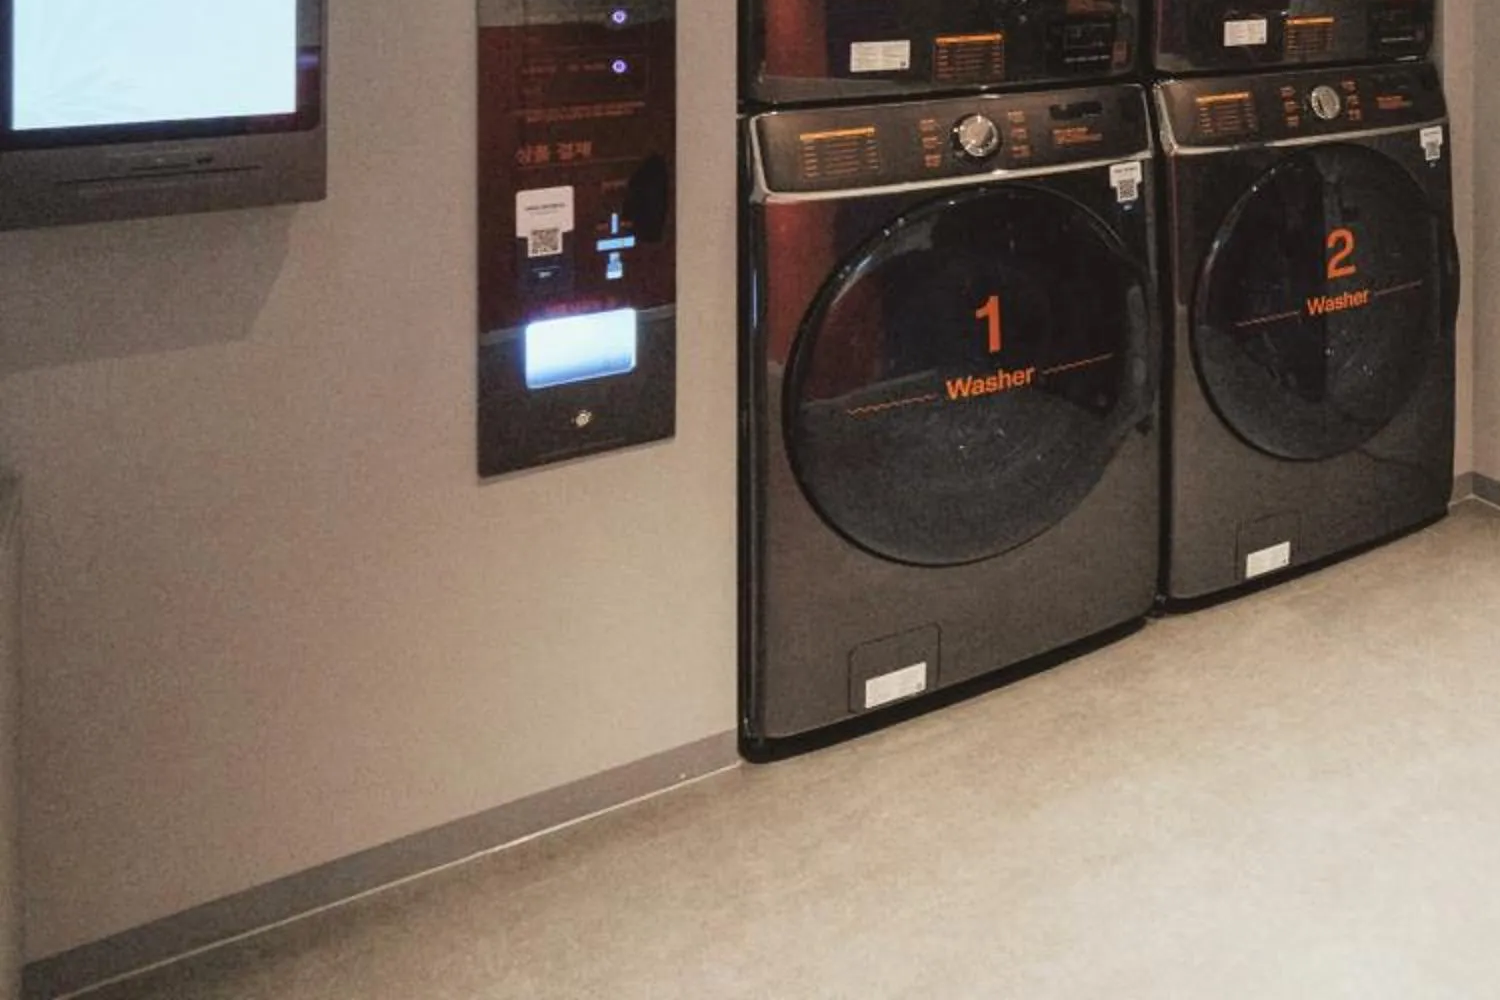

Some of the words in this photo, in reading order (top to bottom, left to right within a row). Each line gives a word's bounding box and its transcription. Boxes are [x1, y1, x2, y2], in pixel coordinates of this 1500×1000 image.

[1325, 227, 1356, 281] 2
[1307, 289, 1371, 316] Washer
[975, 295, 1002, 354] 1
[945, 367, 1036, 400] Washer
